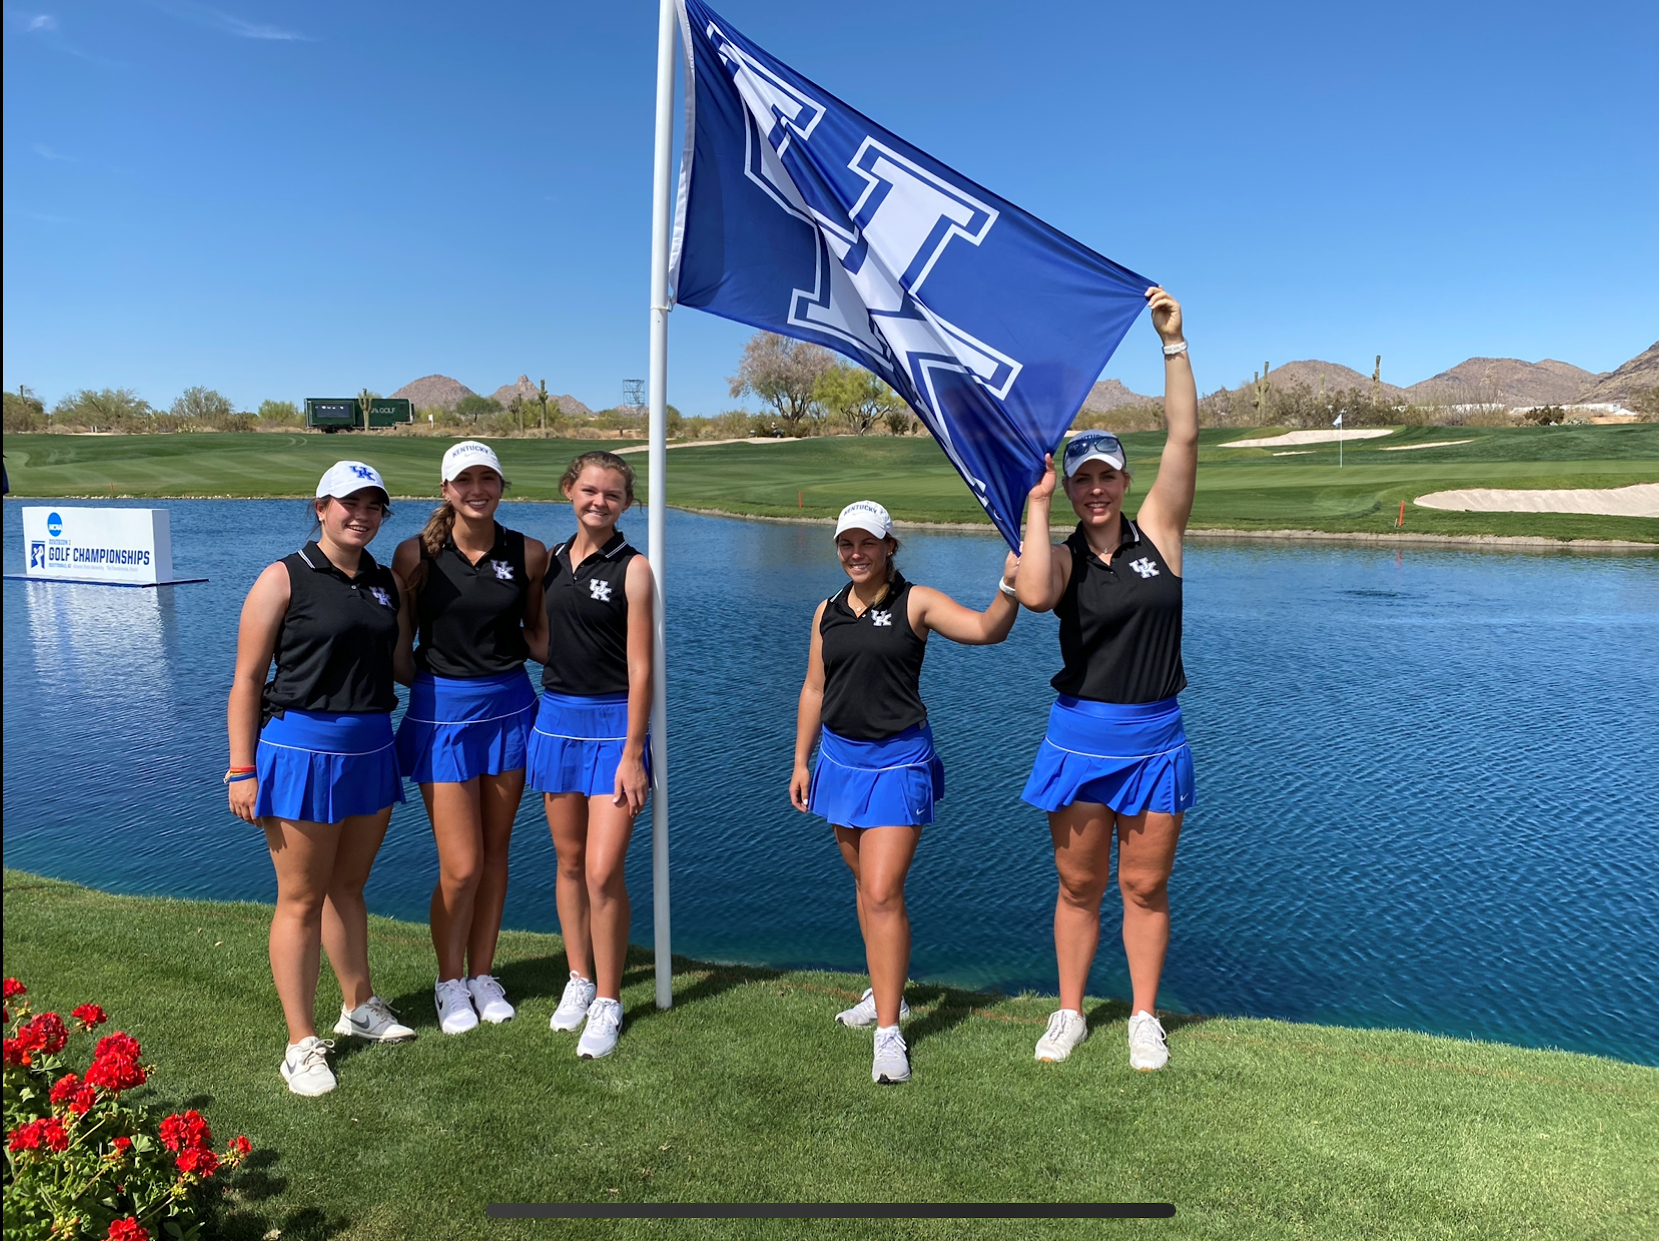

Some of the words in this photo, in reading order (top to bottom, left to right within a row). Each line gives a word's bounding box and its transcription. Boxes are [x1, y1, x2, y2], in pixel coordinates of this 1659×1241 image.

[452, 445, 489, 458] KENTUCKY
[350, 465, 376, 481] UK
[844, 504, 877, 516] KENTUCKY
[49, 547, 70, 561] GOLF
[73, 547, 150, 565] CHAMPIONSHIPS
[490, 559, 515, 580] UK
[1129, 557, 1160, 579] UK
[369, 586, 394, 608] UK
[589, 578, 612, 602] UK
[871, 609, 892, 627] UK
